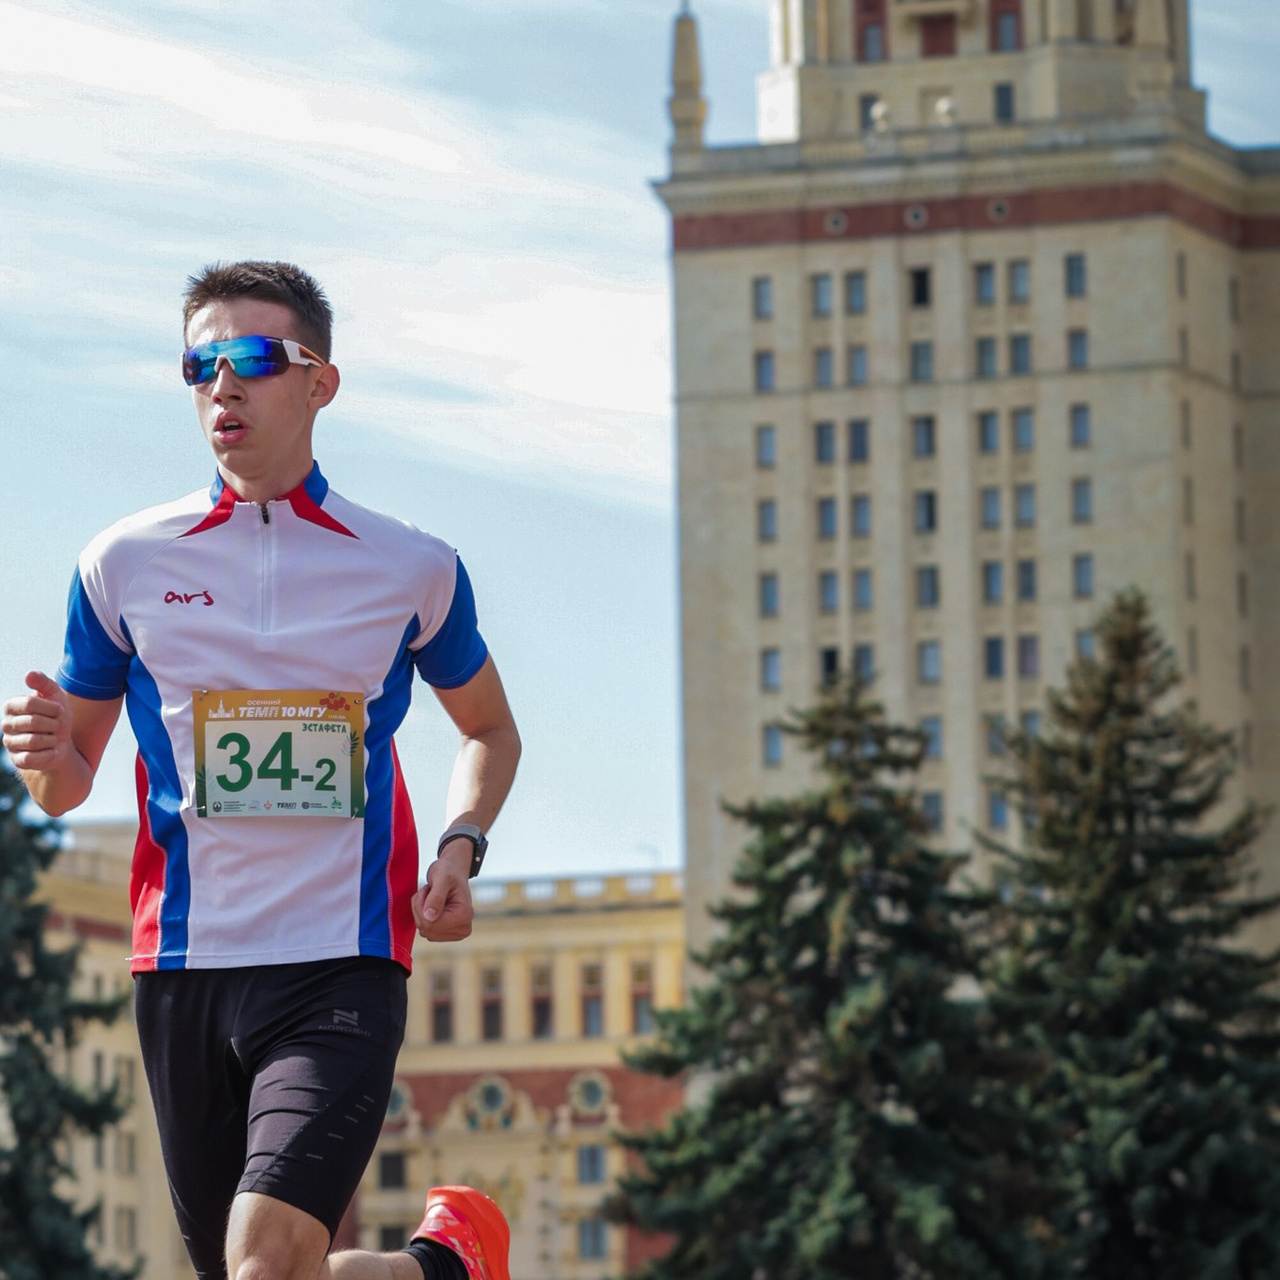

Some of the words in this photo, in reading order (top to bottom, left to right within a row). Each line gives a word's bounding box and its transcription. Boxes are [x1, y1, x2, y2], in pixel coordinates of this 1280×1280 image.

[163, 589, 215, 606] ars
[238, 706, 280, 718] ТЕМП
[281, 707, 295, 718] 10
[297, 706, 327, 718] МГУ
[302, 723, 347, 734] ЭСТАФЕТА
